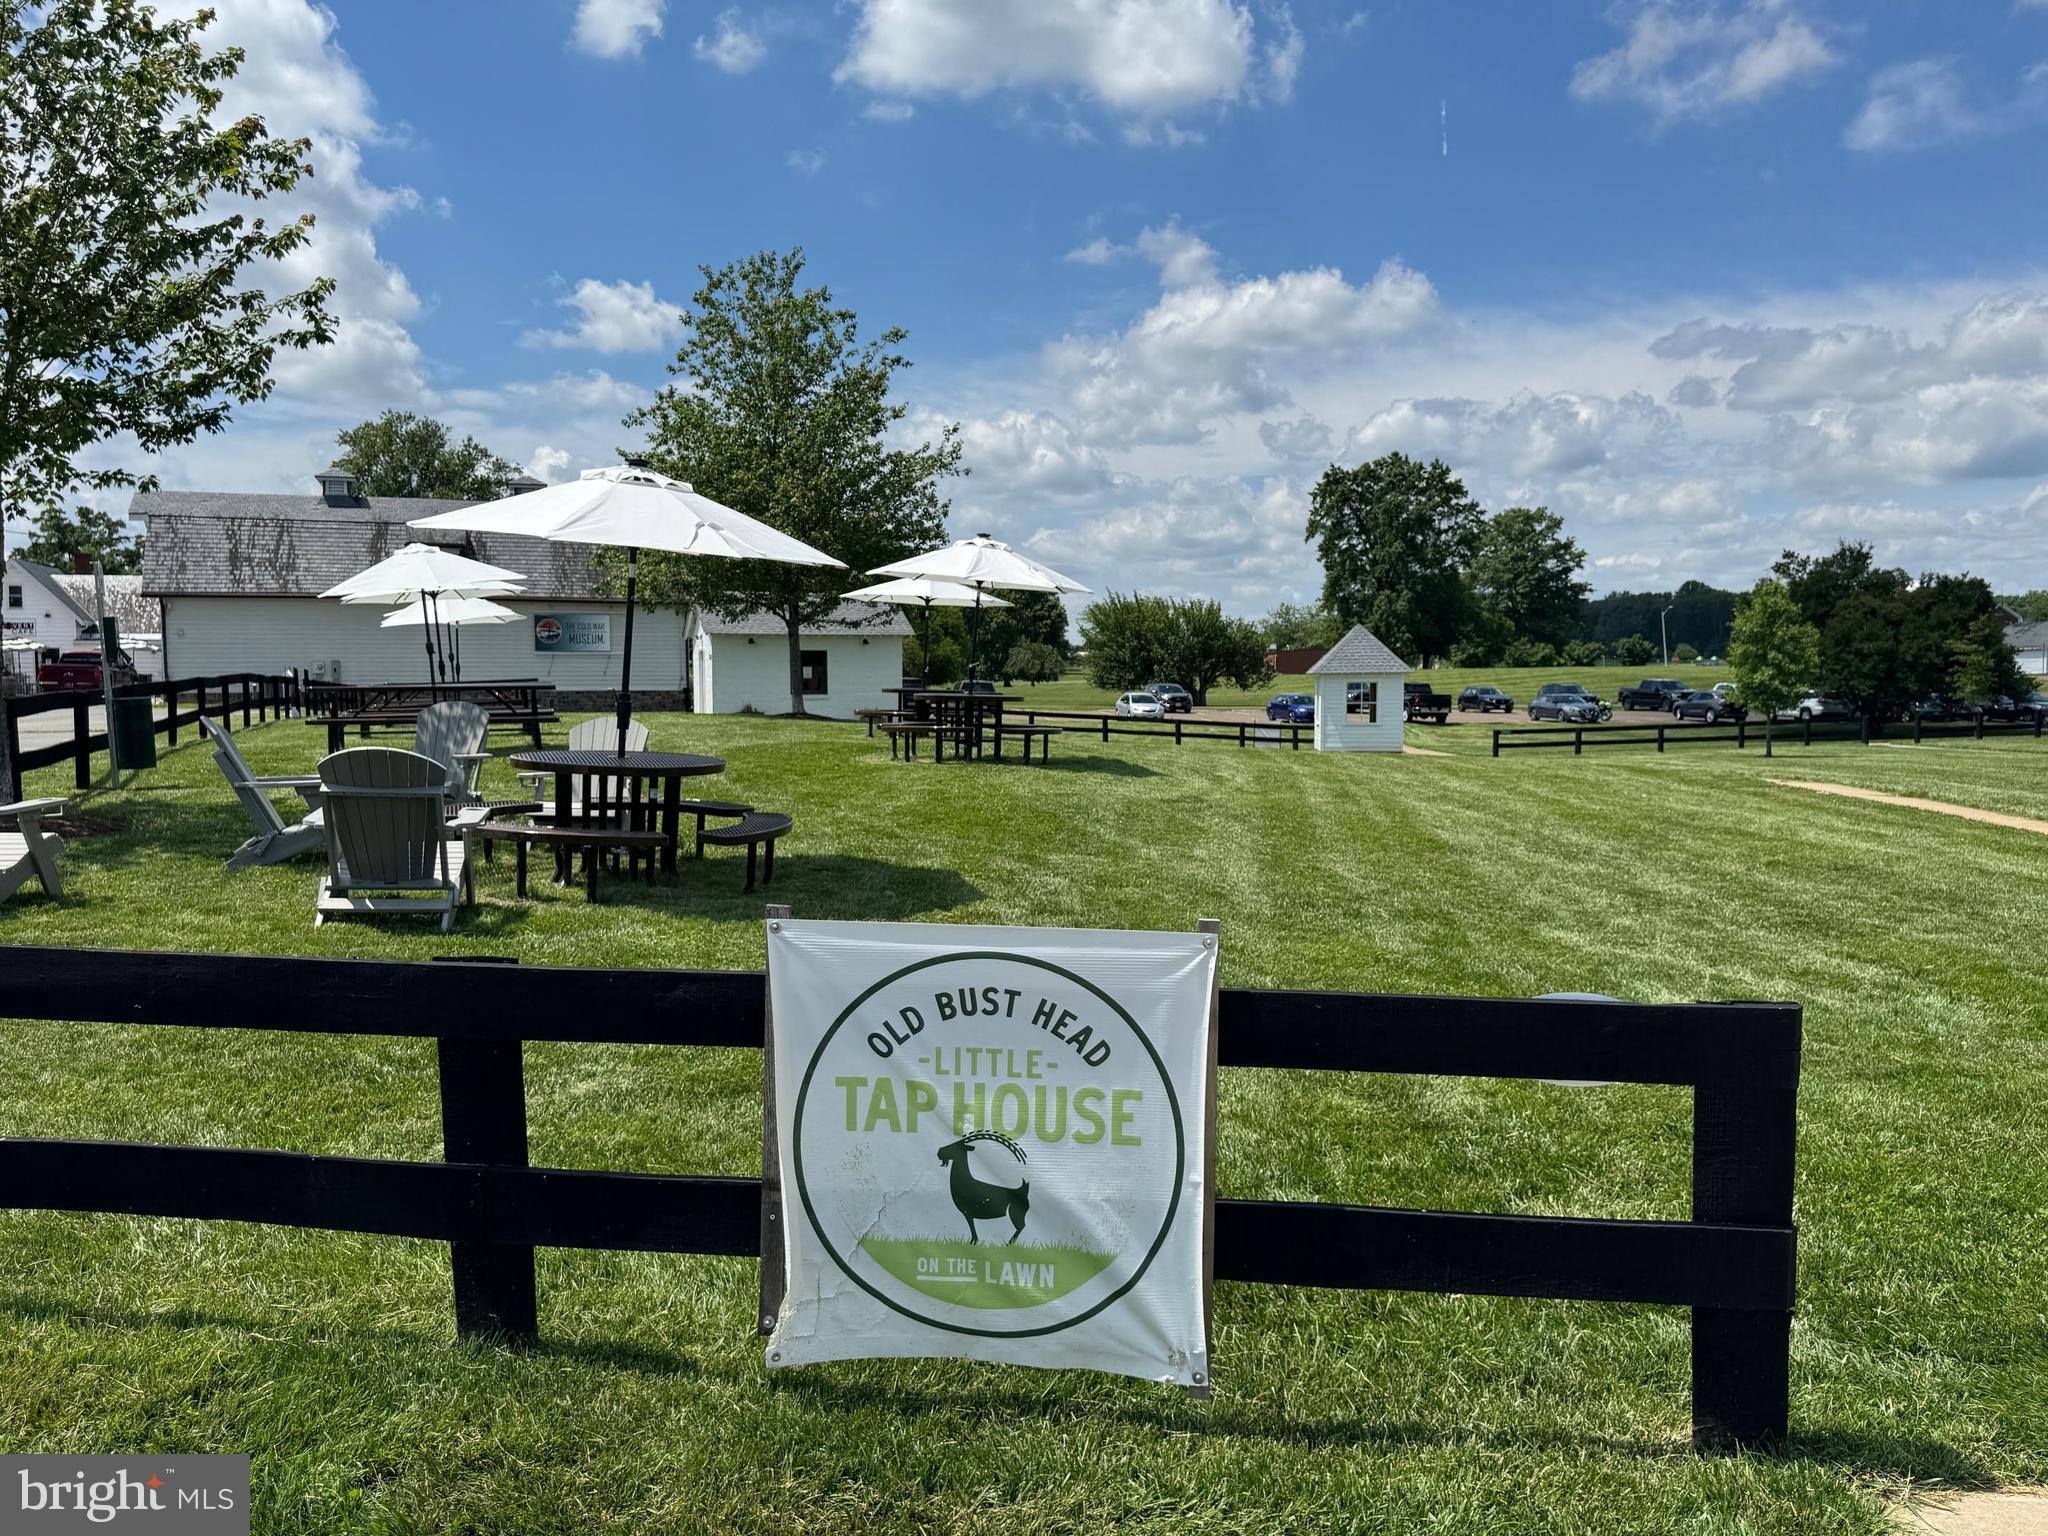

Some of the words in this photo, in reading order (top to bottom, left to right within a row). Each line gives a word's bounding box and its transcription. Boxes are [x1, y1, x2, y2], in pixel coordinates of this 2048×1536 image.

[577, 622, 592, 631] COLD
[593, 622, 606, 631] WAR
[867, 1006, 925, 1059] OLD
[935, 986, 1022, 1022] BUST
[1031, 998, 1112, 1067] HEAD
[835, 1076, 938, 1134] TAP
[952, 1081, 1144, 1147] HOUSE
[917, 1257, 939, 1273] ON
[946, 1257, 977, 1274] THE
[984, 1261, 1055, 1289] LAWN
